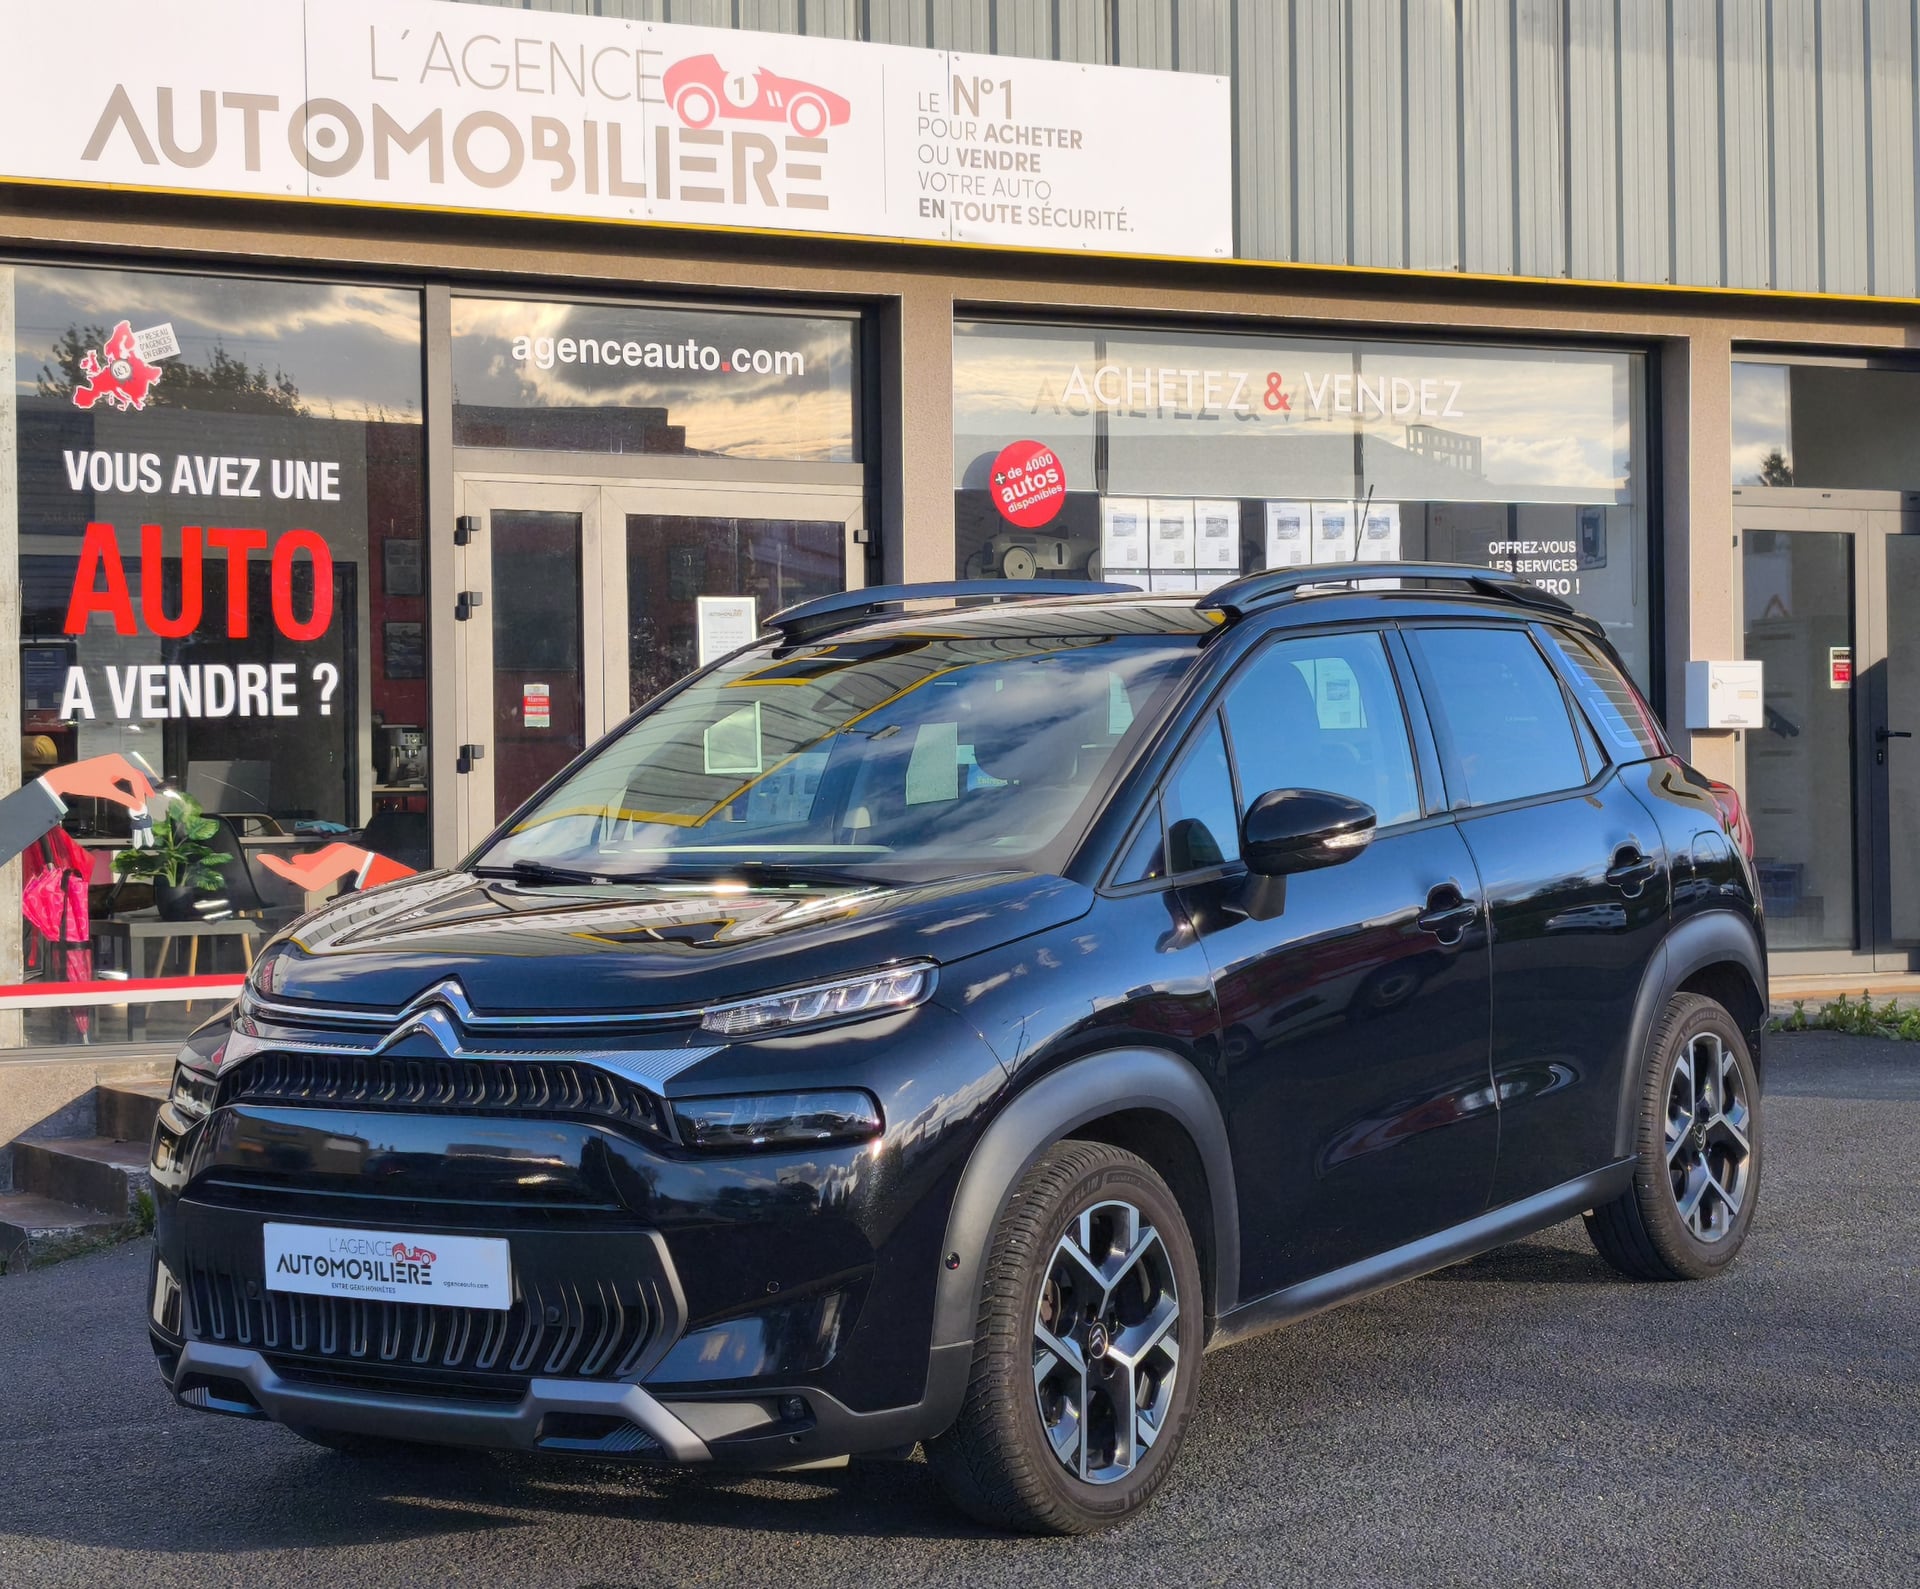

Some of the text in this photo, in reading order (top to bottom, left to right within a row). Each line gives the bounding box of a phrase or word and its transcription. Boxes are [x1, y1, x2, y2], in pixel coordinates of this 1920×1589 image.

[370, 25, 664, 104] L'AGENCE
[918, 91, 940, 113] LE
[918, 116, 1083, 150] POUR ACHETER
[918, 144, 1041, 173] OU VENDRE
[918, 171, 1052, 200] VOTRE AUTO
[919, 198, 1135, 232] EN TOUTE SÉCURITÉ.
[511, 335, 805, 376] agenceauto.com
[1061, 364, 1465, 418] ACHETEZ & VENDEZ
[63, 450, 341, 501] VOUS AVEZ UNE
[1008, 466, 1023, 480] de
[1025, 453, 1054, 473] 4000
[1002, 468, 1059, 503] autos
[1008, 485, 1063, 513] disponibles
[1488, 541, 1577, 554] OFFREZ-VOUS
[63, 521, 334, 641] AUTO
[1516, 559, 1578, 573] SERVICES
[60, 662, 339, 721] A VENDRE ?
[329, 1237, 393, 1257] L'AGENCE
[331, 1282, 349, 1290] ENTRE
